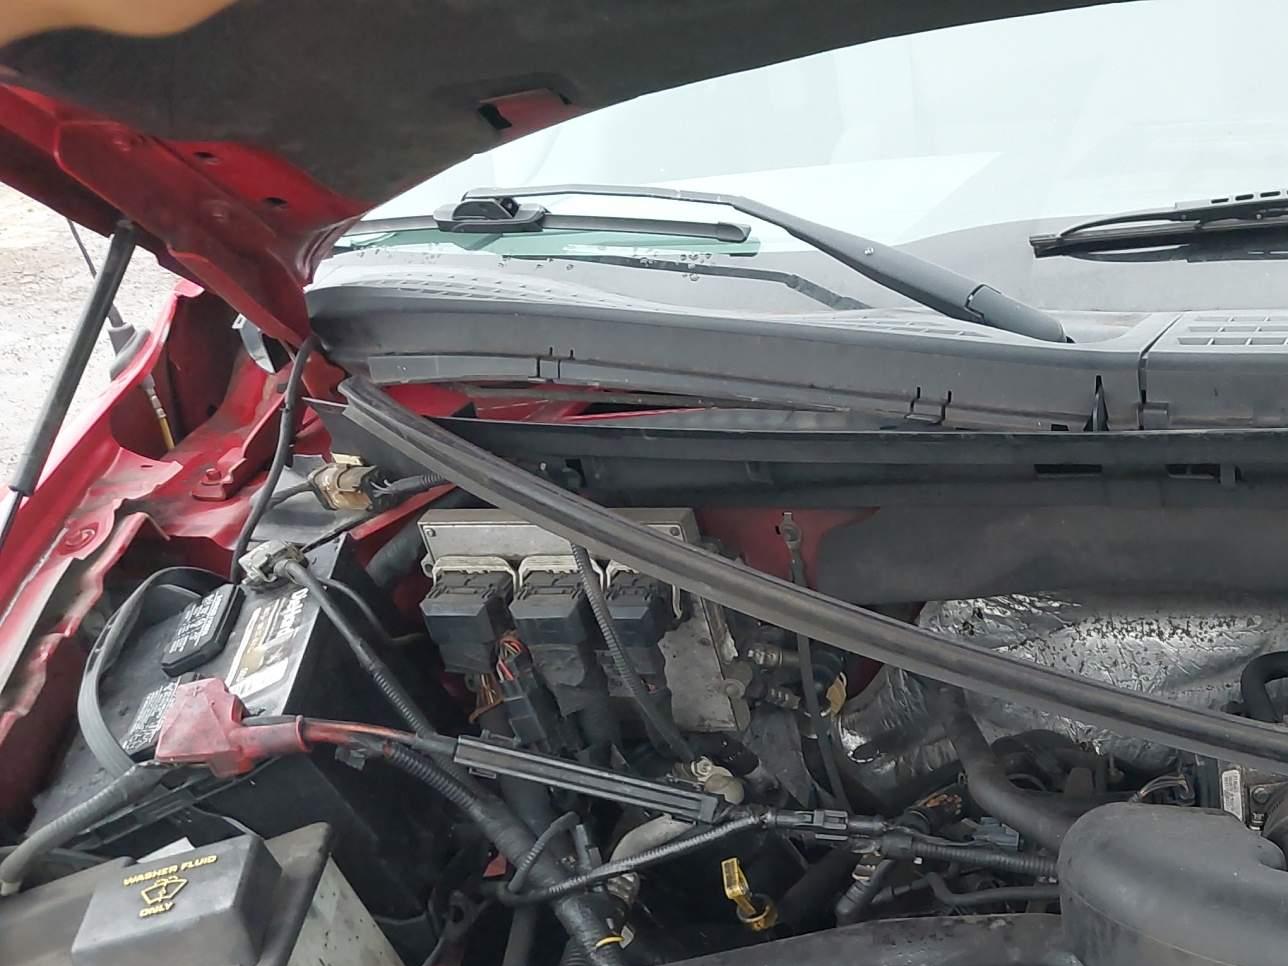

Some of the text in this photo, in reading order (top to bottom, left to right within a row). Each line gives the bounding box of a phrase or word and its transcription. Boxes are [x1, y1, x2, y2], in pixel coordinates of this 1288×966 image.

[123, 854, 218, 887] WASHER FLUID
[138, 901, 175, 918] ONLY
